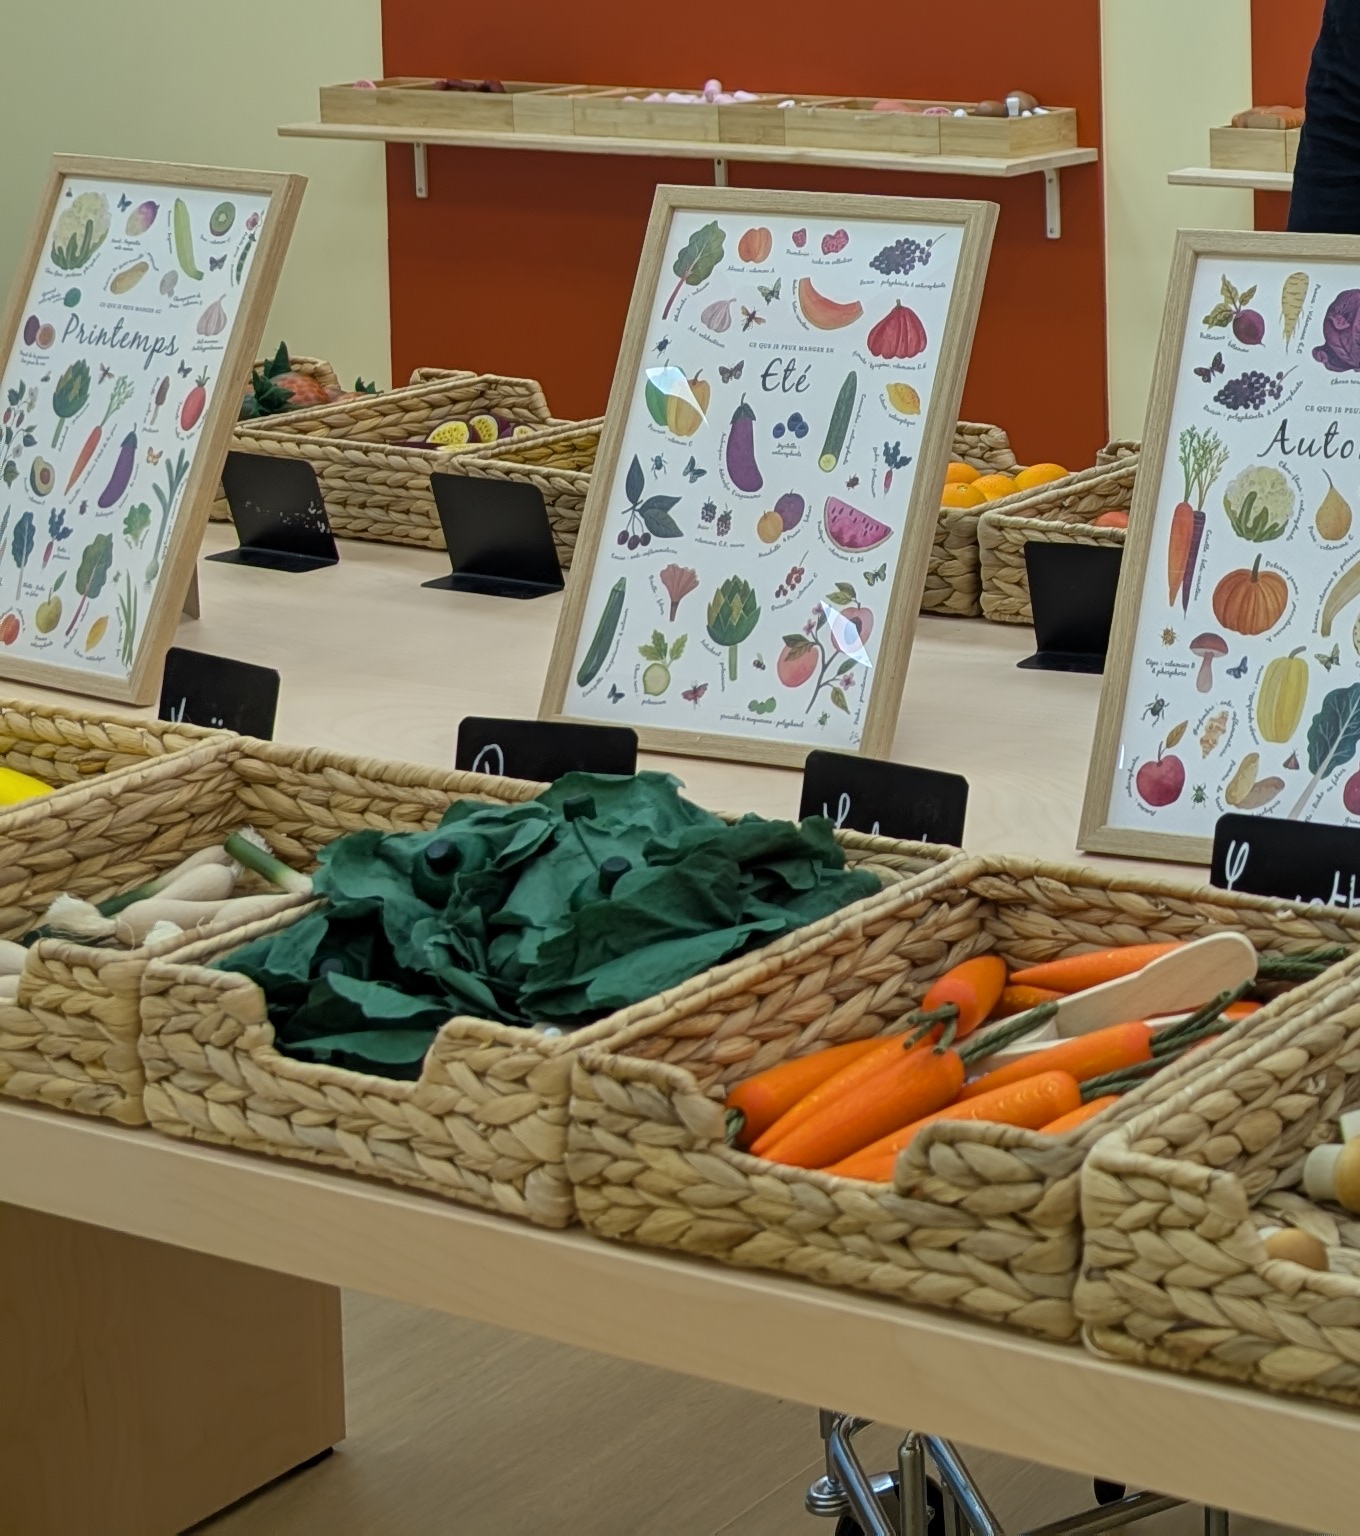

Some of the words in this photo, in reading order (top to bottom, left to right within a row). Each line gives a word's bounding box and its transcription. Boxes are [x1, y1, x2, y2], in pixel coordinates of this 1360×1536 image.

[61, 313, 180, 371] Printemps
[1316, 405, 1333, 413] QUE
[1334, 406, 1342, 414] JE
